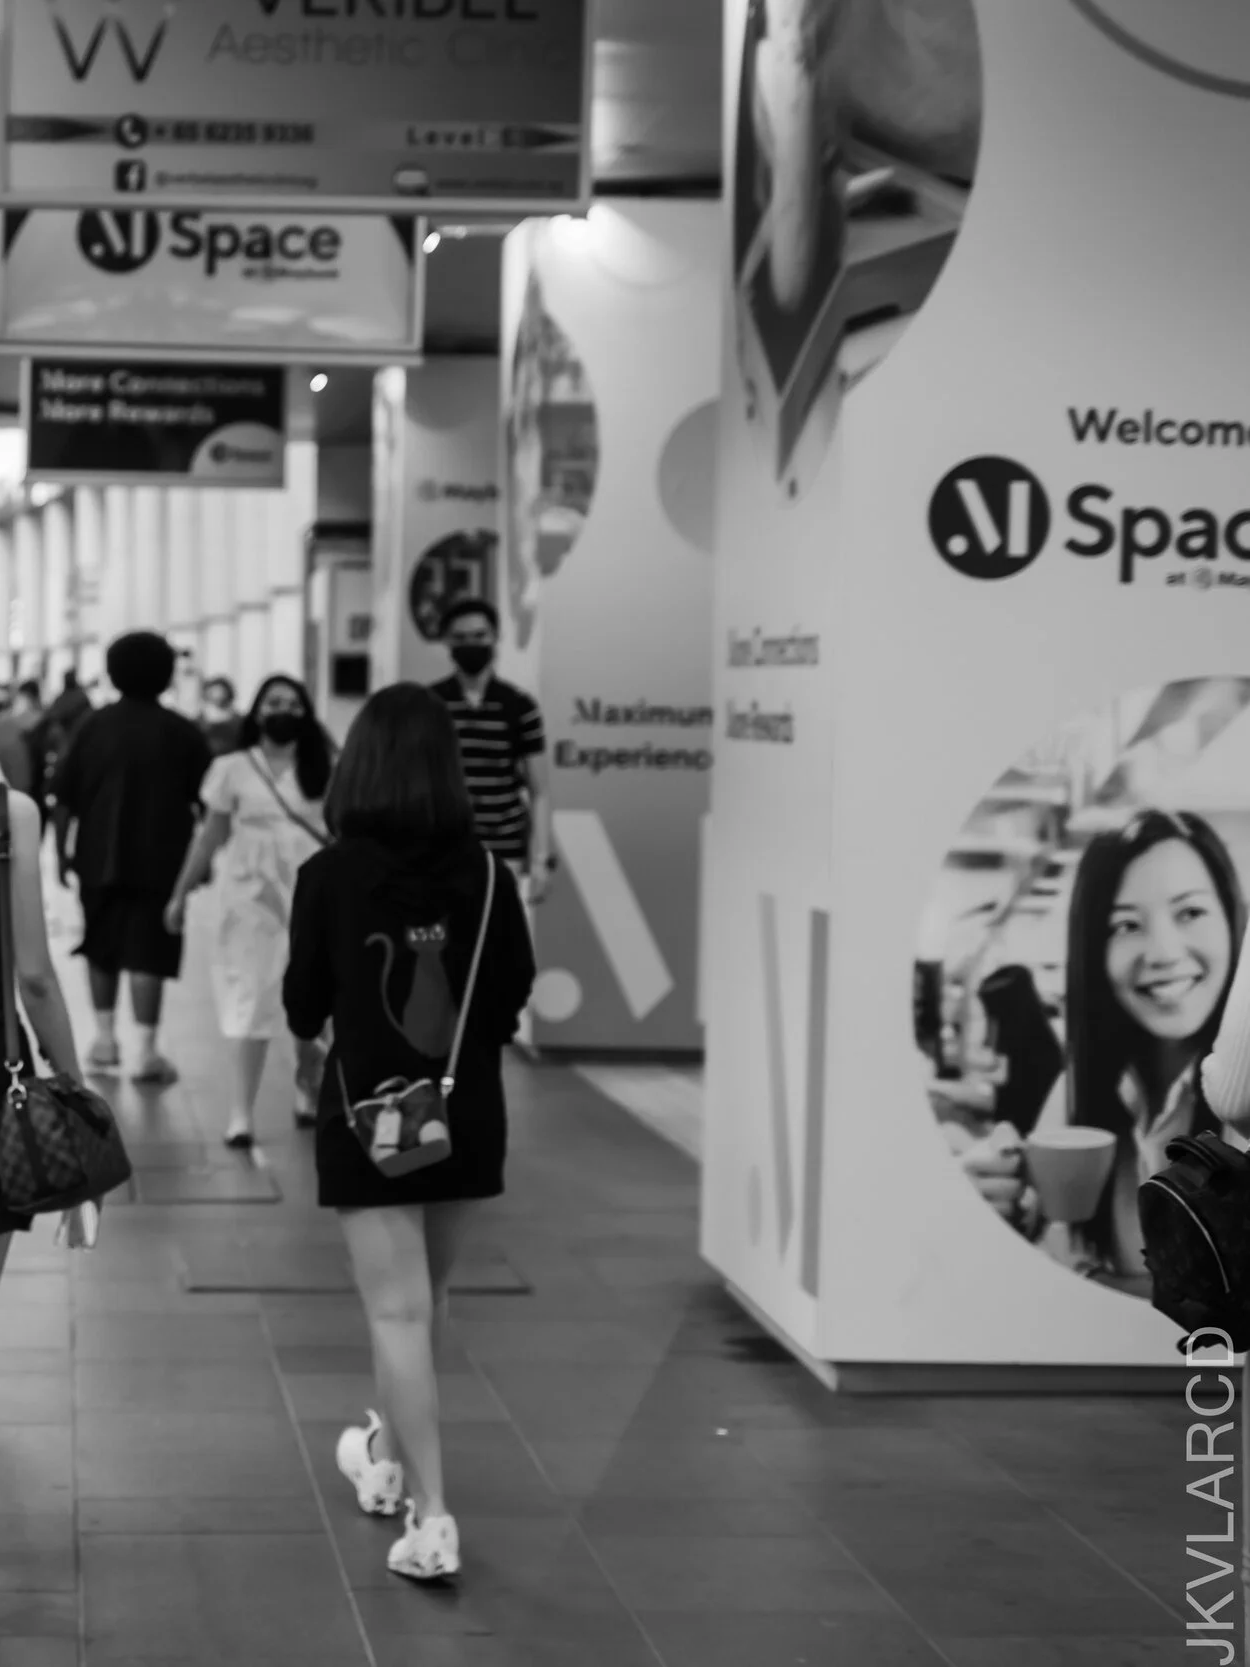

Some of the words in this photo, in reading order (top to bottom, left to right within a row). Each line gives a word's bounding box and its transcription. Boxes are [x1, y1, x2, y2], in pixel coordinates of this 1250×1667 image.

[204, 22, 424, 66] Aesthetic
[167, 208, 342, 278] Space
[1067, 406, 1250, 447] Welcom
